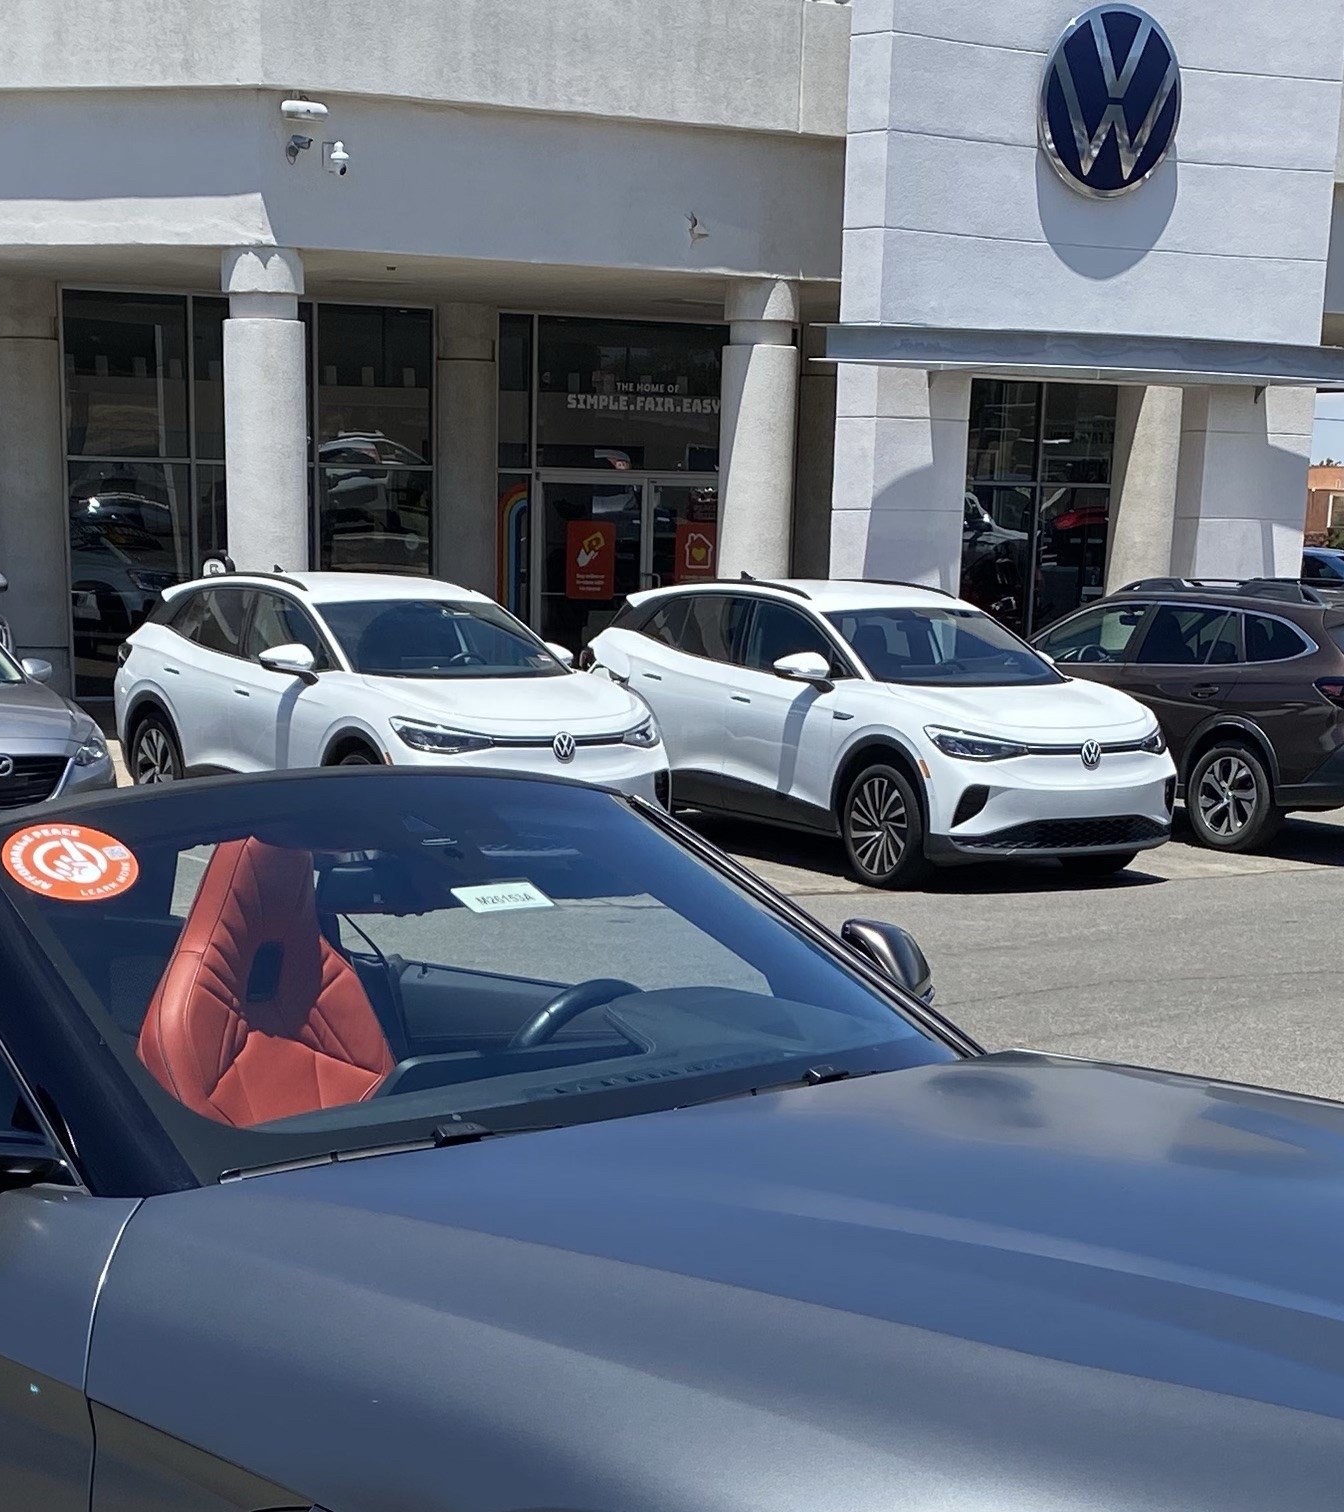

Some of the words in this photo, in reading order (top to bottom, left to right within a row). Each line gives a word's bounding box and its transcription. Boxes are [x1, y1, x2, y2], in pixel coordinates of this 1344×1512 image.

[1046, 9, 1179, 184] VW
[616, 382, 634, 392] THE
[636, 383, 665, 393] HOME
[667, 384, 681, 394] OF
[554, 733, 575, 758] VW
[1083, 741, 1100, 765] VW
[10, 834, 54, 891] AFFORDABLE
[32, 828, 81, 840] PEACE
[79, 881, 120, 897] LEARN
[116, 861, 132, 884] MORE
